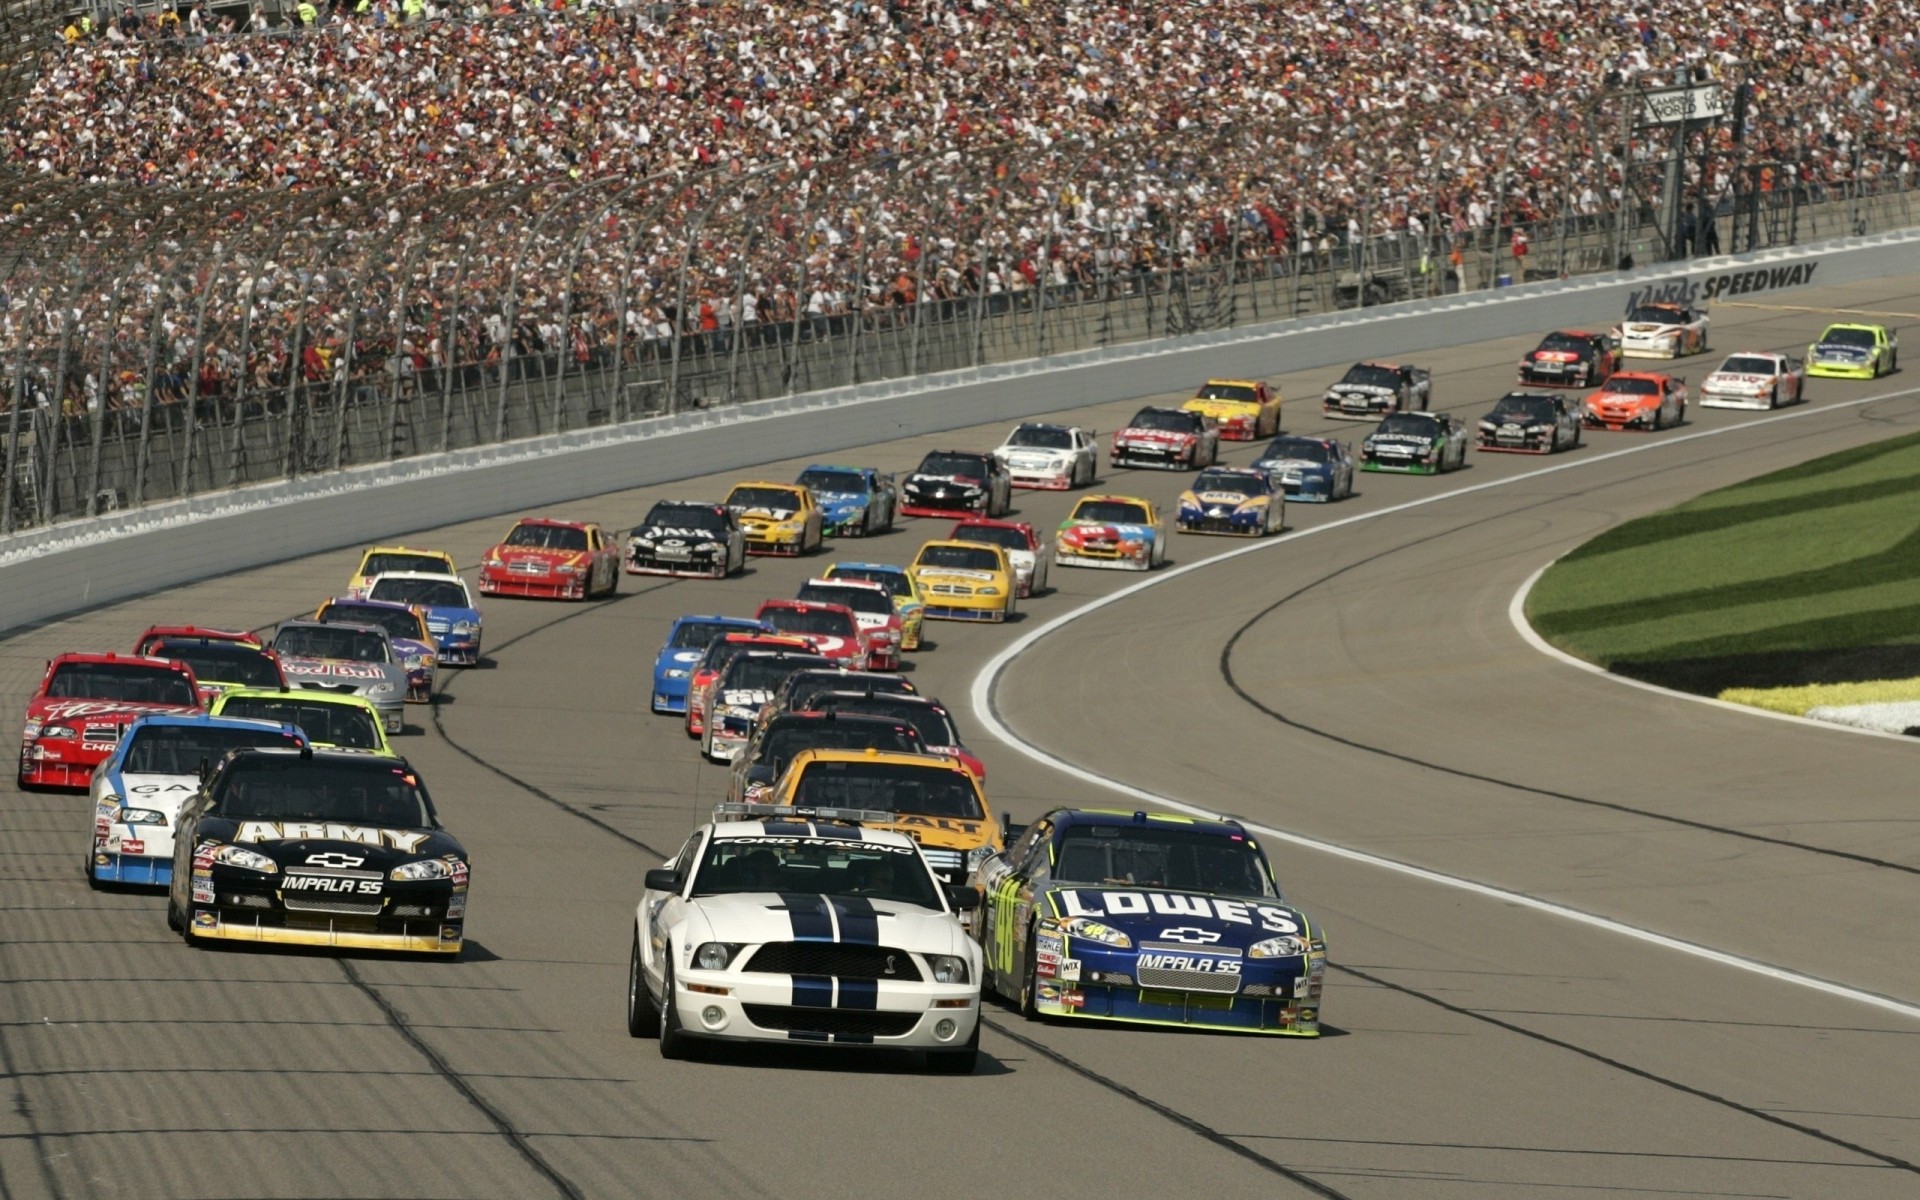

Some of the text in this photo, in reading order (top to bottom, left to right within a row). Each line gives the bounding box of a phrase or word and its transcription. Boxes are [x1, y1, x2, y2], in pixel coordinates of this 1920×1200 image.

[1625, 262, 1817, 315] KANSAS SPEEDWAY
[1205, 493, 1240, 501] NAPA
[644, 526, 715, 540] JACK
[332, 665, 386, 680] Bull
[233, 820, 430, 854] ARMY
[714, 837, 915, 856] FORD RACING
[281, 876, 384, 895] IMPALA SS
[1061, 889, 1299, 933] LOWE'S
[1062, 961, 1079, 971] WIX
[1137, 953, 1243, 974] IMPALA SS
